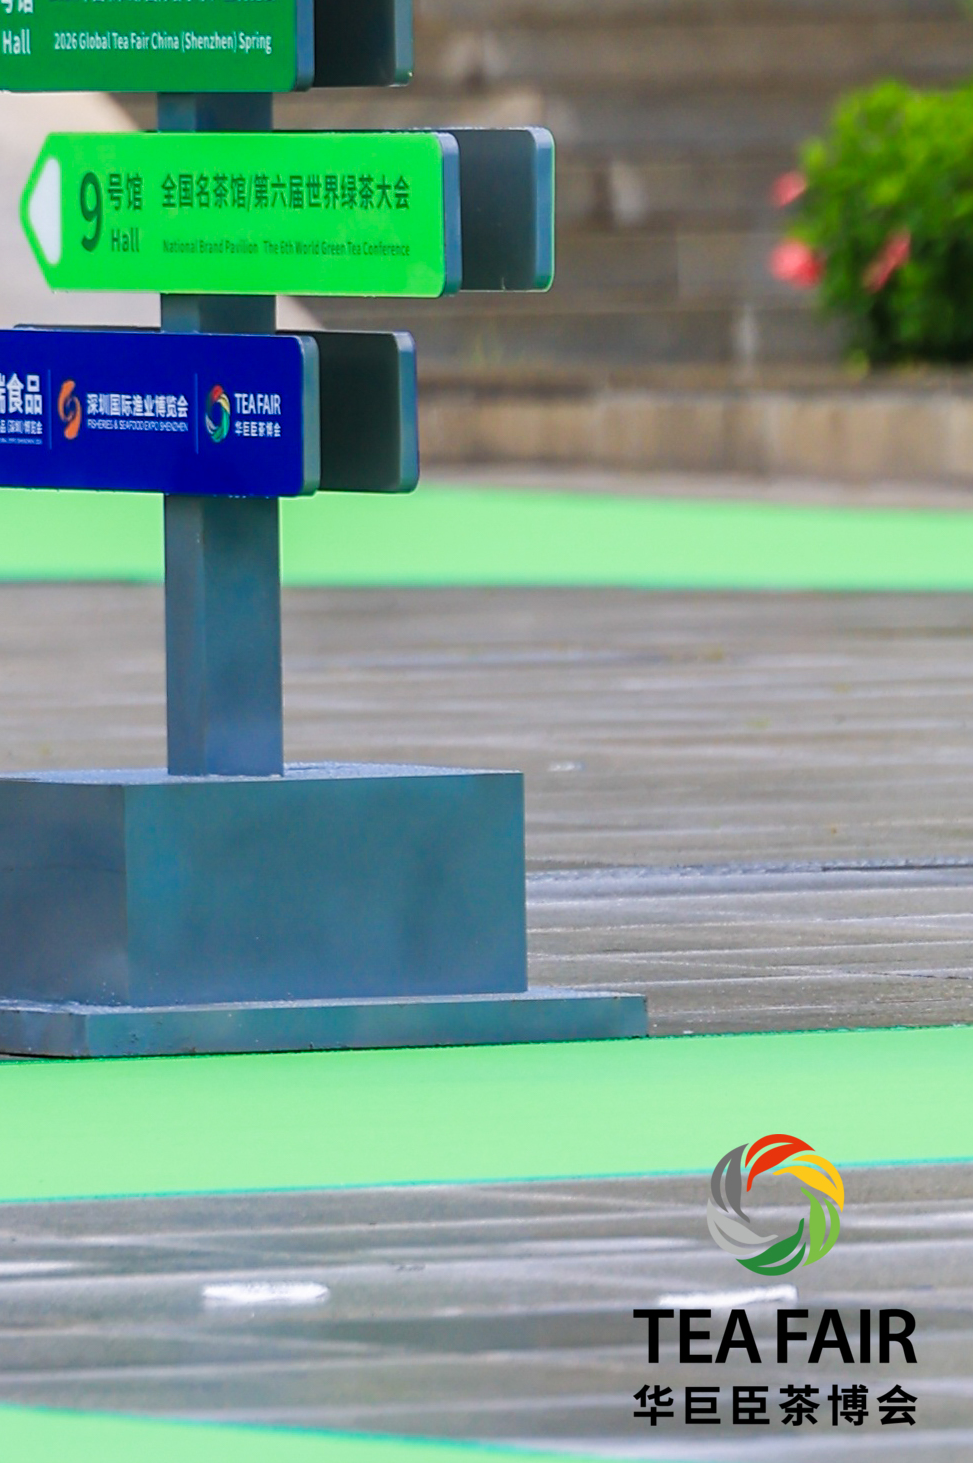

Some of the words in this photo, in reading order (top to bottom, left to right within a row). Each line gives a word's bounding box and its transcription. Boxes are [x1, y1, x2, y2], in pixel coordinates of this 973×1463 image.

[2, 29, 31, 55] Hall
[54, 32, 78, 50] 2026
[79, 31, 111, 50] Global
[112, 32, 129, 50] Tea
[130, 31, 149, 50] Fair
[151, 31, 180, 50] China
[181, 31, 237, 53] (Shenzhen)
[239, 31, 273, 54] Spring
[108, 173, 143, 211] 号馆
[161, 174, 410, 212] 全国名茶馆/第六届世界绿茶大会
[80, 171, 104, 252] 9
[111, 227, 140, 253] Hall
[163, 239, 198, 254] National
[199, 239, 224, 254] Brand
[263, 239, 279, 254] The
[295, 240, 320, 255] World
[321, 240, 346, 255] Green
[347, 241, 361, 255] Tea
[362, 241, 410, 256] Conference
[87, 393, 188, 418] 深圳国际渔业博览会
[234, 393, 256, 415] TEA
[257, 393, 281, 415] FAIR
